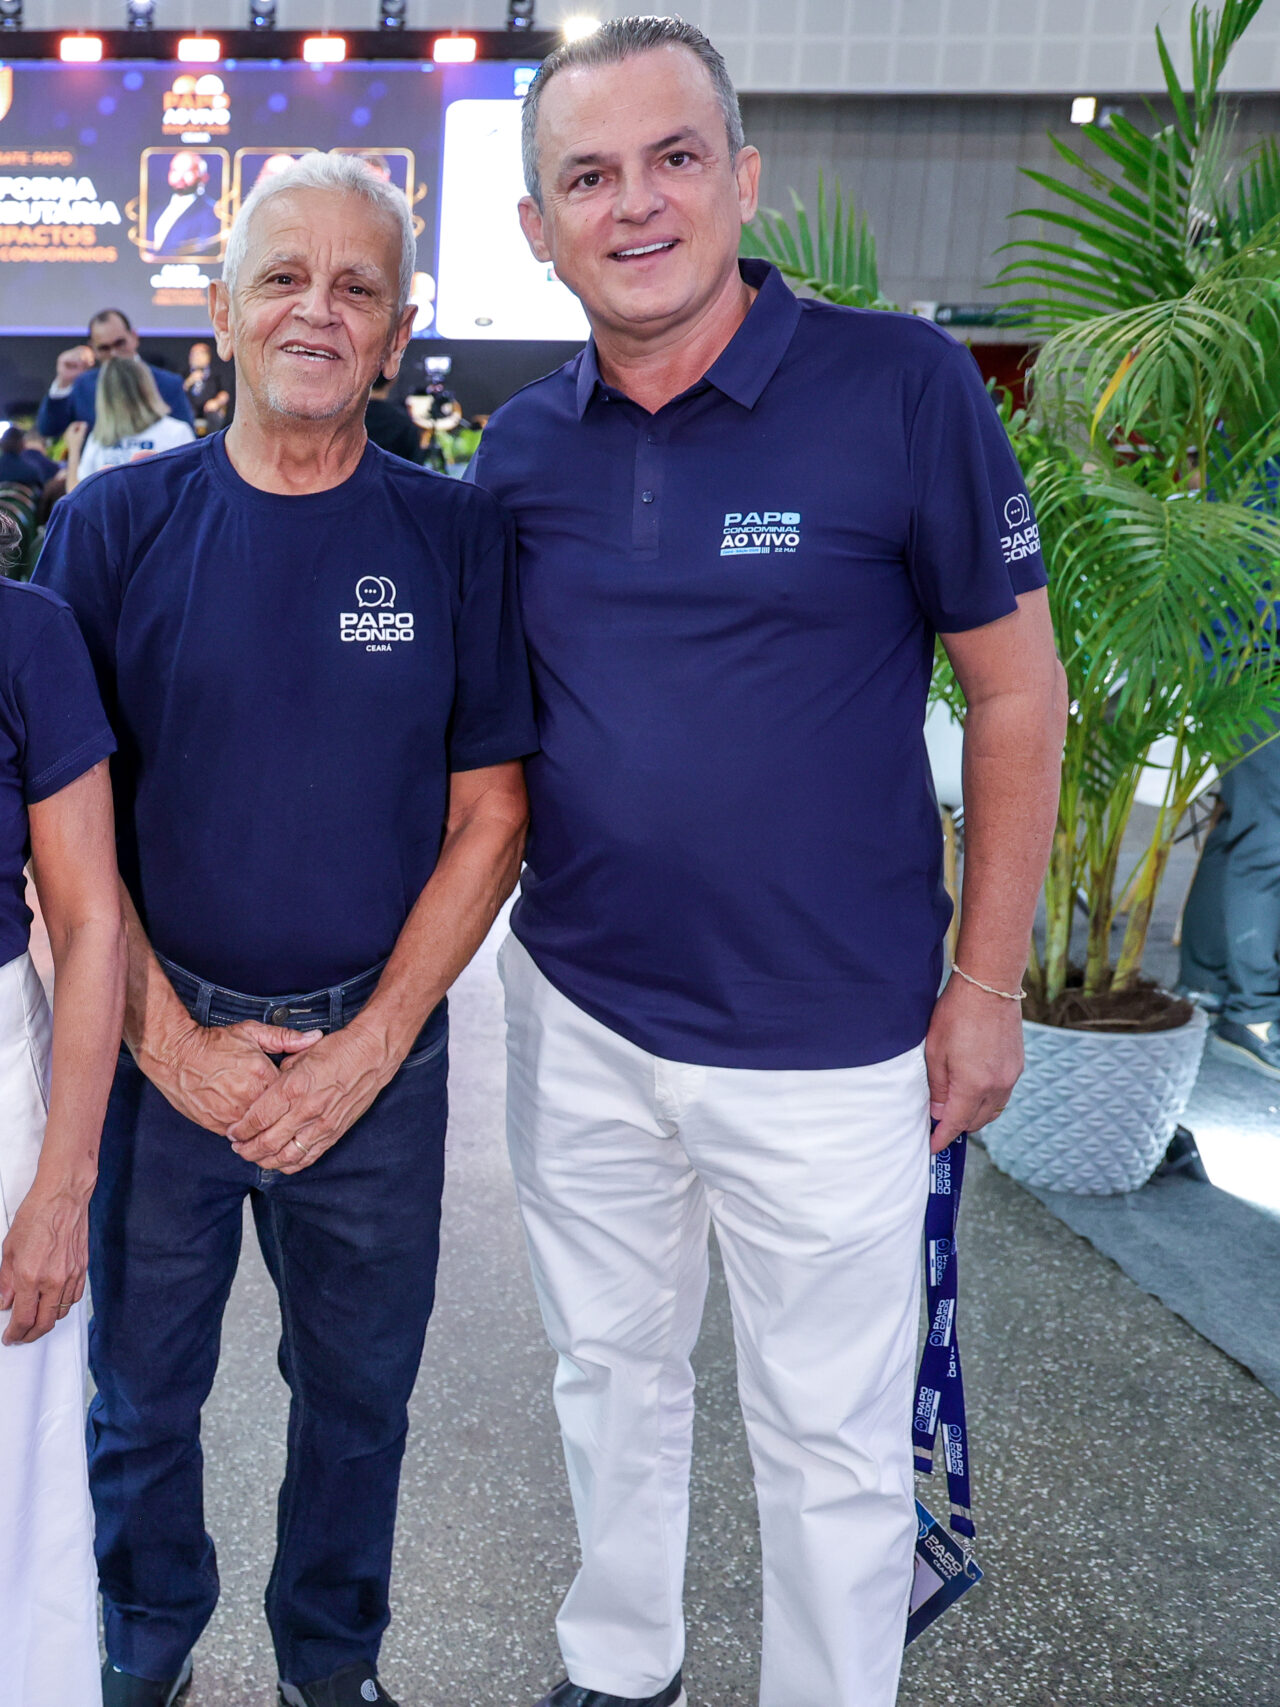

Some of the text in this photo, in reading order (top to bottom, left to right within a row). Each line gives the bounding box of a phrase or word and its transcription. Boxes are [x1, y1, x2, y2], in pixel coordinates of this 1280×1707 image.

[723, 526, 800, 534] CONDOMINIAL
[724, 512, 800, 526] PAPO
[721, 533, 799, 548] AO VIVO
[1000, 523, 1039, 549] PAPO
[340, 612, 414, 628] PAPO
[340, 628, 414, 641] CONDO
[366, 643, 392, 651] CEARÁ
[943, 1163, 951, 1194] PAPO
[933, 1299, 946, 1330] PAPO
[939, 1299, 950, 1330] CONDO
[916, 1386, 928, 1415] PAPO
[923, 1388, 934, 1418] CONDO
[949, 1442, 958, 1475] CONDO
[955, 1443, 964, 1476] PAPO
[924, 1539, 958, 1577] CONDO
[928, 1534, 963, 1572] PAPO
